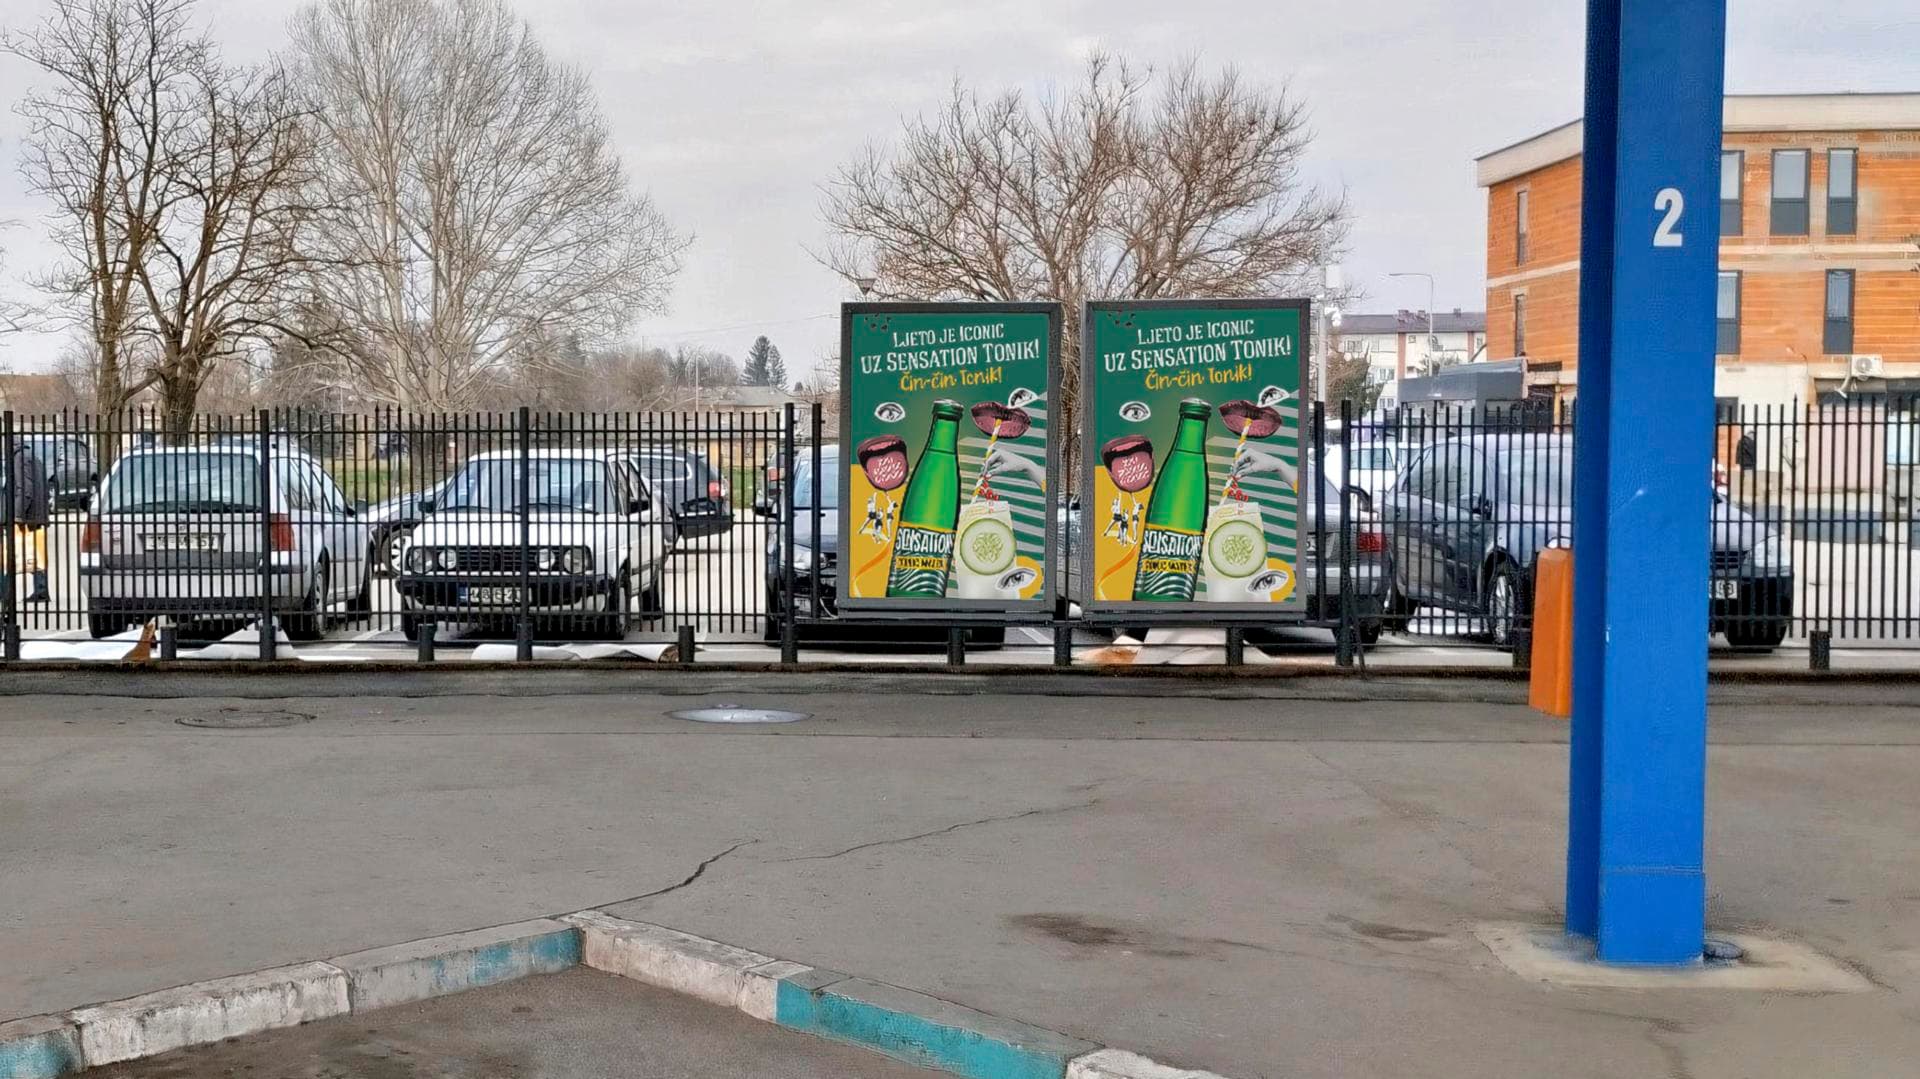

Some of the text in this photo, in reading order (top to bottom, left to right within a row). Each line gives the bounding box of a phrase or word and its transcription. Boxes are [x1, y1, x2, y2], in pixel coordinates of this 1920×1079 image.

[1653, 187, 1684, 247] 2
[893, 323, 1005, 348] LJETO JE ICONIC
[1137, 319, 1254, 345] LJETO JE ICONIC
[861, 338, 1040, 374] UZ SENSATION TONIK!
[1104, 335, 1292, 373] UZ SENSATION TONIK!
[1208, 363, 1253, 385] Tonik!
